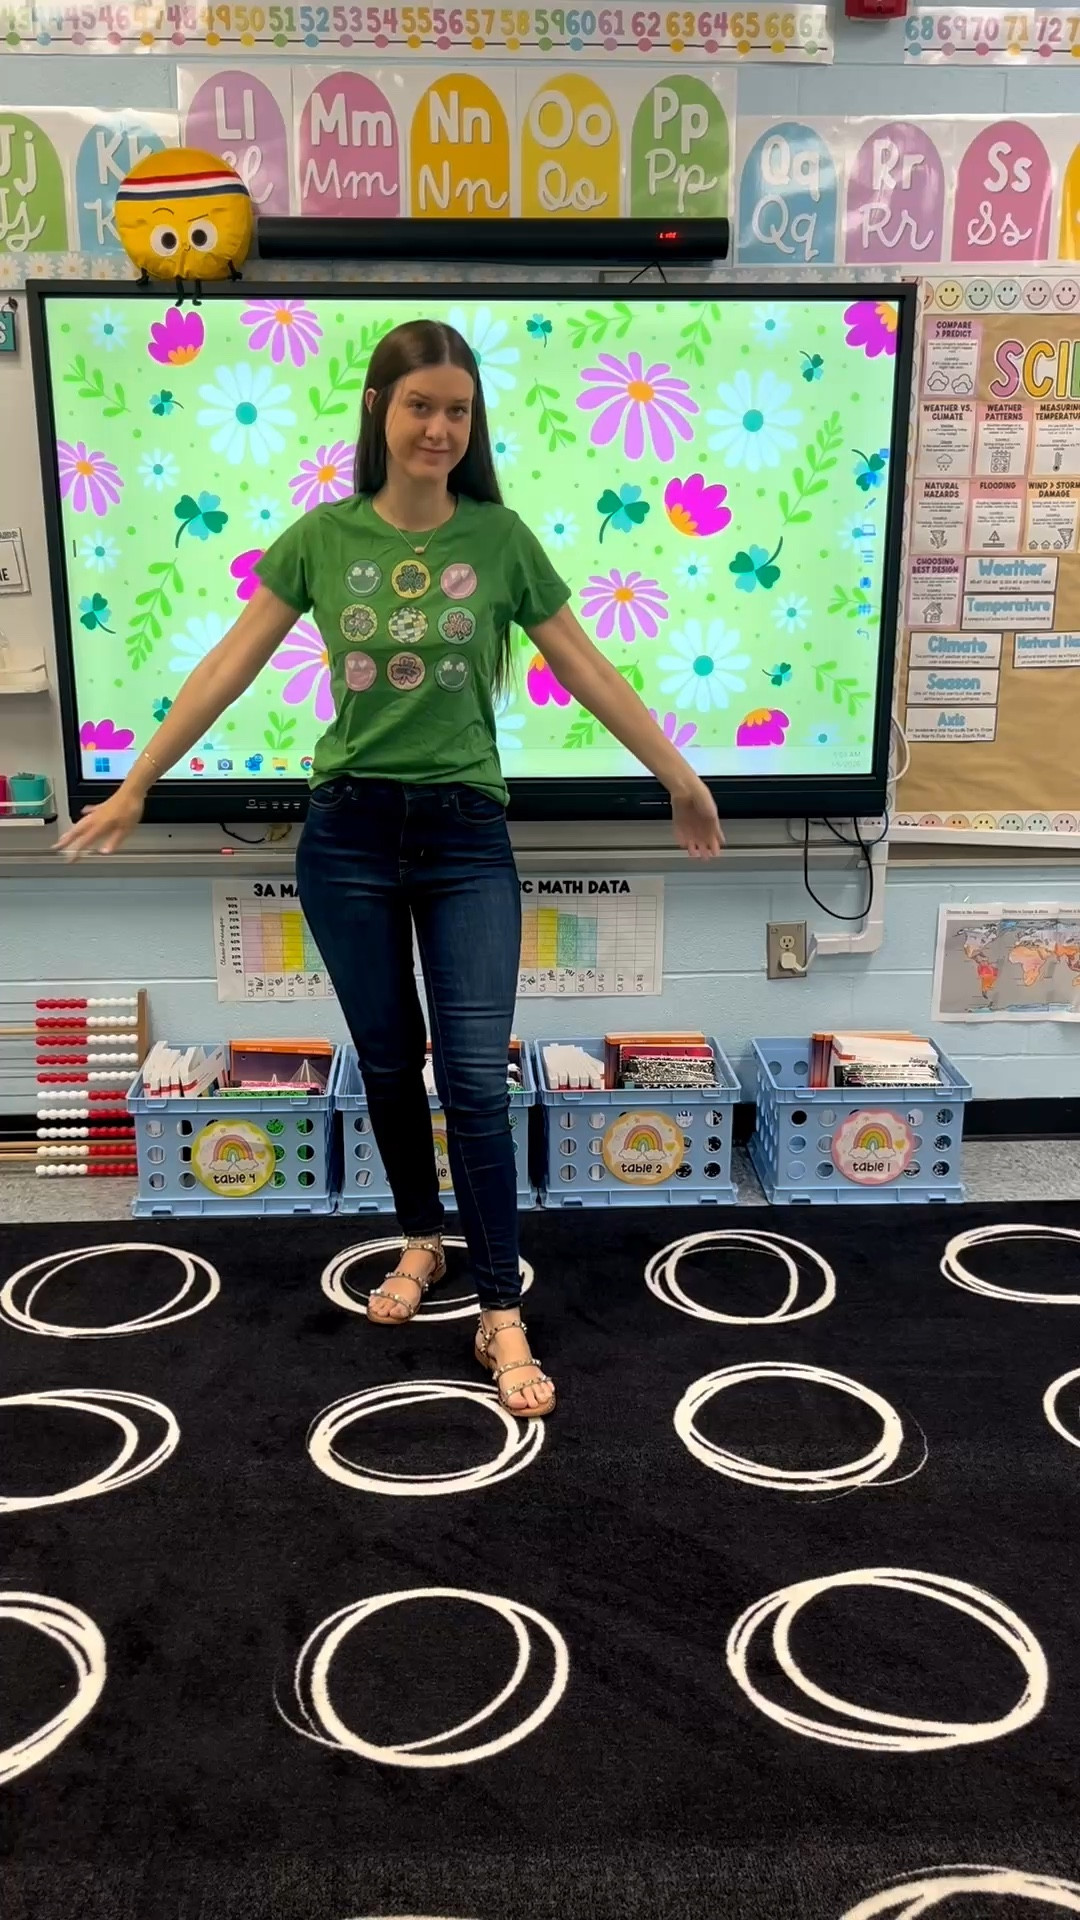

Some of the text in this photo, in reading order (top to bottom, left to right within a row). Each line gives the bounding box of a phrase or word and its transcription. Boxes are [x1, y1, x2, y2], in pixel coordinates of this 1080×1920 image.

[65, 7, 96, 30] 45
[100, 5, 131, 31] 46
[205, 7, 231, 31] 49
[234, 7, 265, 31] 50
[269, 7, 296, 32] 51
[300, 7, 329, 32] 52
[333, 7, 362, 32] 53
[366, 8, 398, 33] 54
[401, 8, 433, 33] 55
[433, 9, 464, 34] 56
[465, 9, 495, 34] 57
[501, 9, 530, 35] 58
[534, 9, 565, 35] 59
[565, 10, 596, 35] 60
[598, 11, 625, 35] 61
[631, 11, 660, 37] 62
[666, 11, 695, 37] 63
[699, 12, 728, 37] 64
[730, 12, 760, 38] 65
[764, 12, 795, 38] 66
[905, 15, 934, 41] 68
[936, 15, 967, 41] 69
[972, 15, 1000, 41] 70
[1004, 15, 1029, 41] 71
[1066, 17, 1080, 42] 7
[215, 86, 255, 140] Ll
[311, 92, 393, 146] Mm
[429, 90, 491, 144] Nn
[529, 89, 612, 148] Oo
[653, 87, 709, 154] Pp
[761, 134, 819, 202] Qq
[873, 137, 925, 190] Rr
[983, 141, 1032, 192] Ss
[303, 158, 398, 199] Mm
[418, 160, 510, 213] Nn
[644, 148, 718, 214] Pp
[752, 194, 819, 262] Qq
[859, 202, 935, 250] Rr
[967, 200, 1033, 247] Ss
[937, 321, 972, 329] COMPARE
[923, 404, 958, 412] WEATHER
[925, 482, 959, 490] NATURAL
[1039, 490, 1070, 498] DAMAGE
[912, 566, 930, 574] BEST
[978, 559, 1046, 576] Weather
[967, 597, 1051, 615] Temperature
[928, 635, 987, 653] Climate
[1018, 635, 1060, 649] Natural
[926, 673, 980, 690] Season
[937, 712, 966, 726] Axis
[253, 883, 275, 897] 3A
[538, 880, 583, 894] MATH
[588, 880, 631, 894] DATA
[621, 1163, 662, 1173] table 2
[853, 1162, 884, 1172] table
[213, 1173, 256, 1184] table 4
